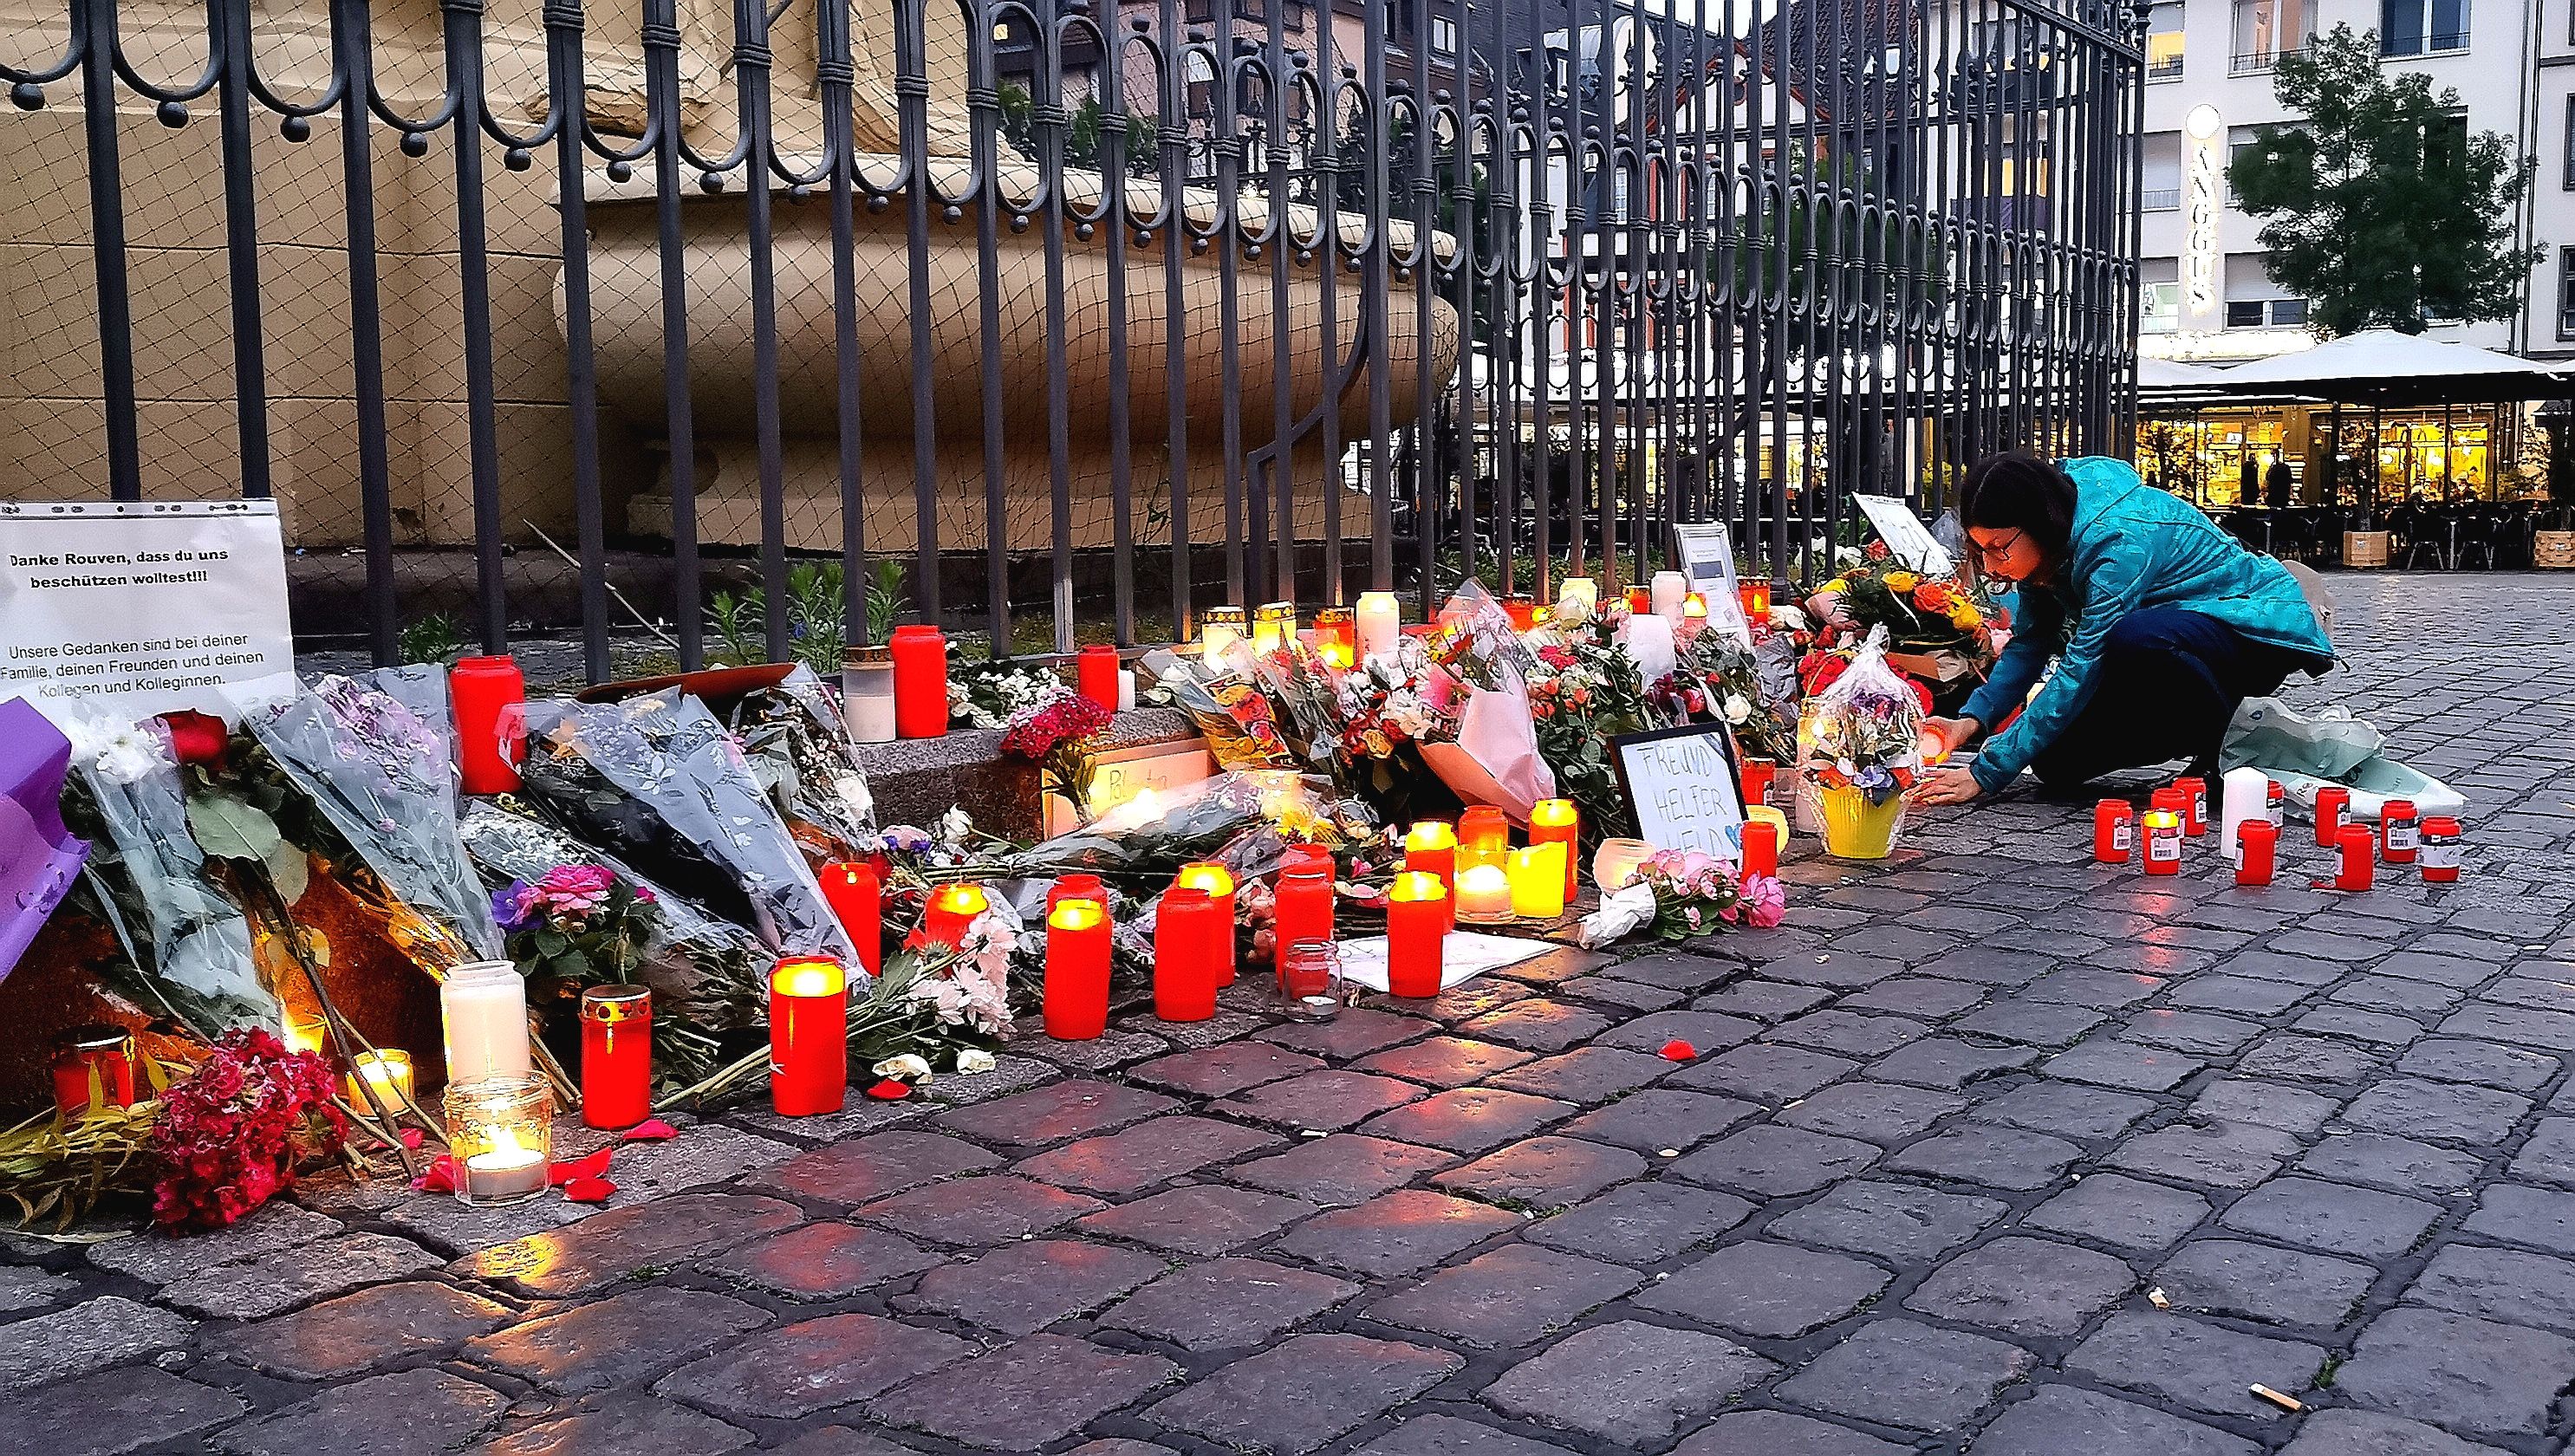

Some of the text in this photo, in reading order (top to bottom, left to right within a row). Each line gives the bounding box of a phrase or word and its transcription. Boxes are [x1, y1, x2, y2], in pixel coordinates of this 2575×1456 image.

[10, 548, 228, 567] Danke Rouven, dass du uns
[30, 570, 207, 588] beschützen wolltest!!!
[9, 633, 249, 660] Unsere Gedanken sind bei deiner
[0, 651, 264, 680] Familie, deinen Freunden und deinen
[38, 673, 226, 699] Kollegen und Kolleginnen.
[1636, 744, 1713, 777] FREUND
[1653, 783, 1727, 823] HELFER
